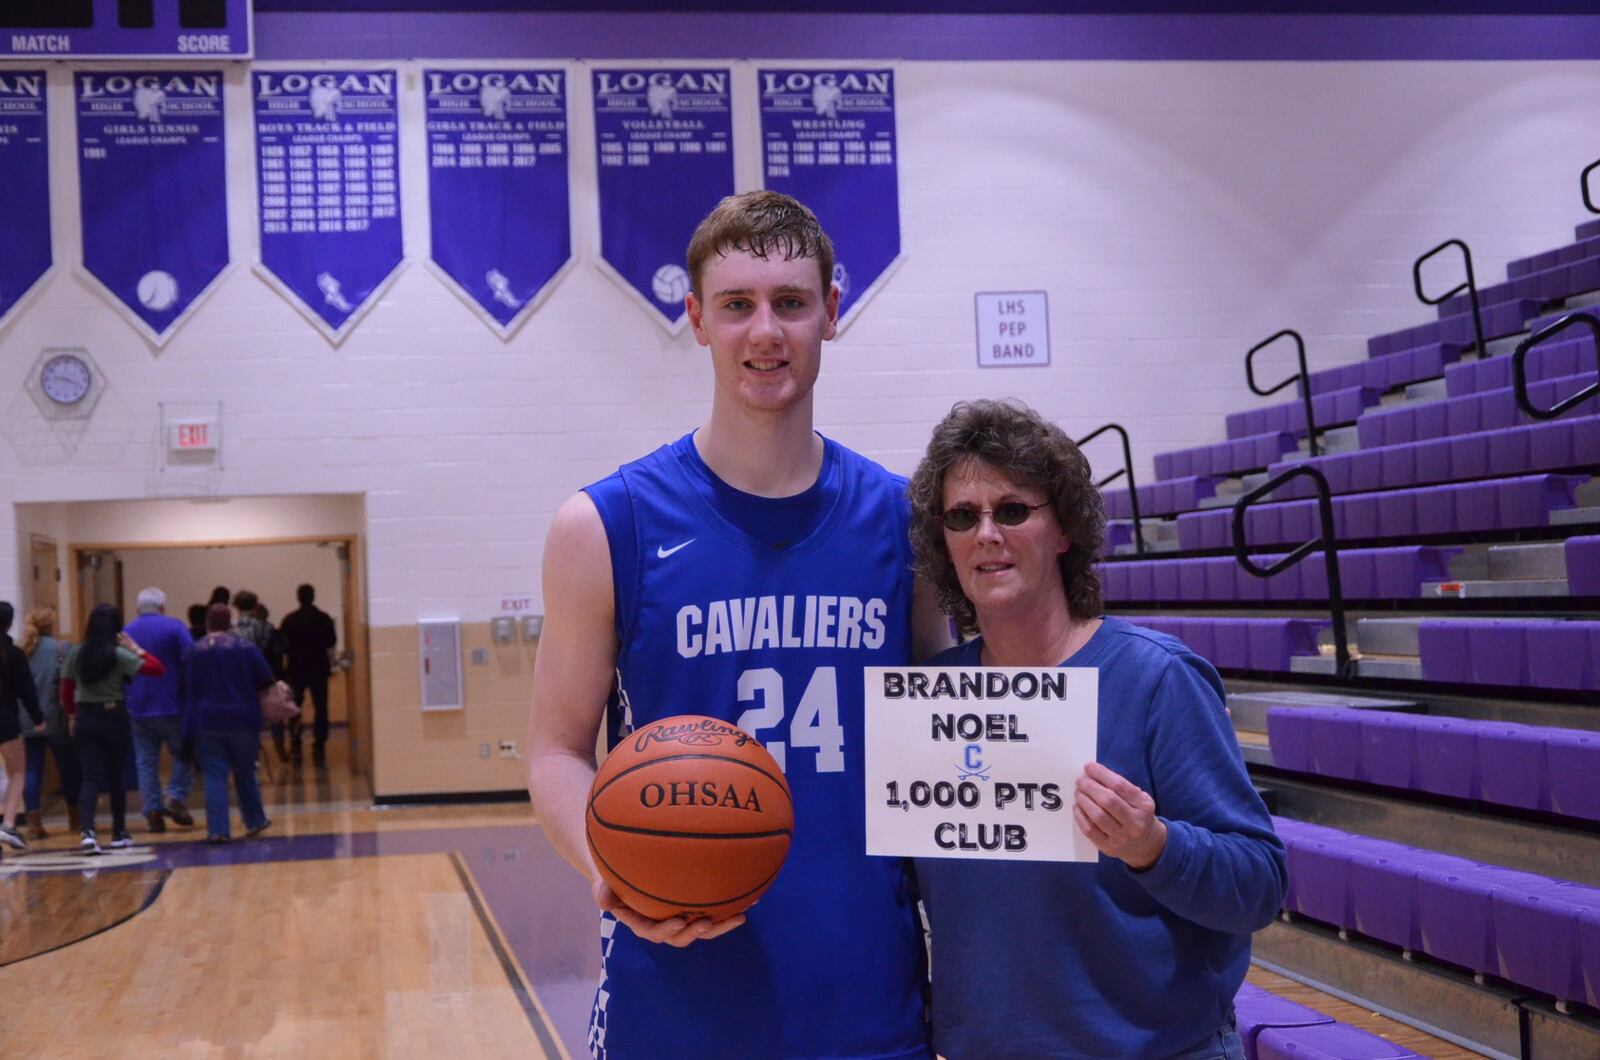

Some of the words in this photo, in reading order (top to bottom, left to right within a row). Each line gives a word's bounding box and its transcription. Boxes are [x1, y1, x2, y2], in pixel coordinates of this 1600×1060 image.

[12, 35, 70, 51] MATCH
[178, 35, 230, 52] SCORE
[80, 75, 219, 97] LOGAN
[258, 74, 393, 95] LOGAN
[429, 73, 561, 94] LOGAN
[597, 73, 727, 94] LOGAN
[764, 73, 889, 94] LOGAN
[103, 125, 145, 134] GIRLS
[149, 124, 199, 134] TENNIS
[258, 123, 294, 133] BOYS
[297, 122, 341, 133] TRACK
[343, 123, 354, 132] &
[356, 122, 396, 131] FIELD
[427, 121, 466, 131] GIRLS
[469, 121, 513, 130] TRACK
[622, 120, 704, 129] VOLLEYBALL
[792, 119, 866, 129] WRESTLING
[115, 136, 149, 145] LEAGUE
[292, 134, 326, 143] LEAGUE
[513, 155, 536, 168] 2017
[345, 220, 369, 231] 2017
[998, 300, 1025, 315] LHS
[999, 321, 1026, 336] PEP
[992, 342, 1035, 358] BAND
[178, 423, 208, 446] EXIT
[501, 598, 530, 611] EXIT
[676, 595, 887, 658] CAVALIERS
[883, 672, 1067, 700] BRANDON
[737, 666, 845, 773] 24
[931, 713, 1029, 742] NOEL
[963, 743, 983, 769] C
[640, 781, 763, 813] OHSAA
[886, 780, 980, 812] 1,000
[993, 782, 1063, 812] PTS
[934, 822, 1028, 851] CLUB
